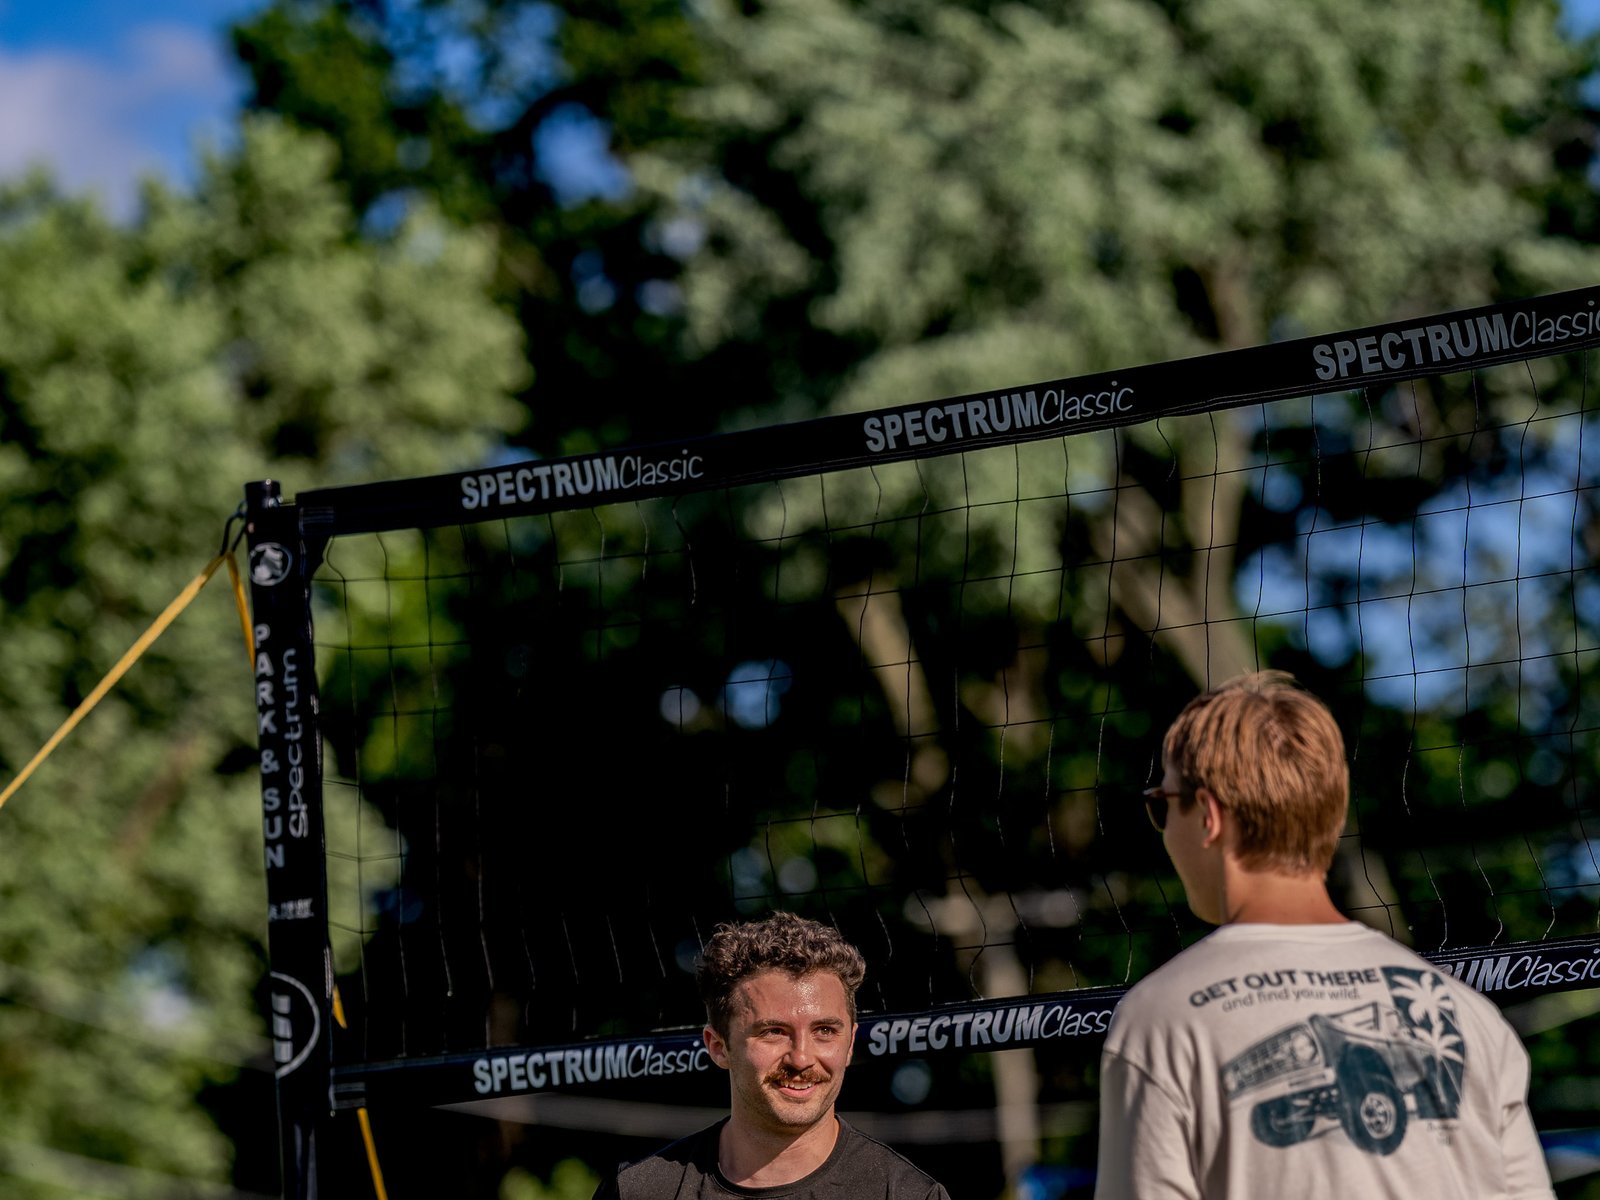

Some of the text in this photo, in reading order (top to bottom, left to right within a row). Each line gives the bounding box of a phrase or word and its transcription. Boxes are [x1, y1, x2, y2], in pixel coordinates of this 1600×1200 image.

[255, 623, 285, 869] PARK & SUN
[1189, 966, 1381, 1008] GET OUT THERE
[1222, 994, 1253, 1013] and
[1257, 988, 1289, 1004] find
[1294, 989, 1324, 1000] your
